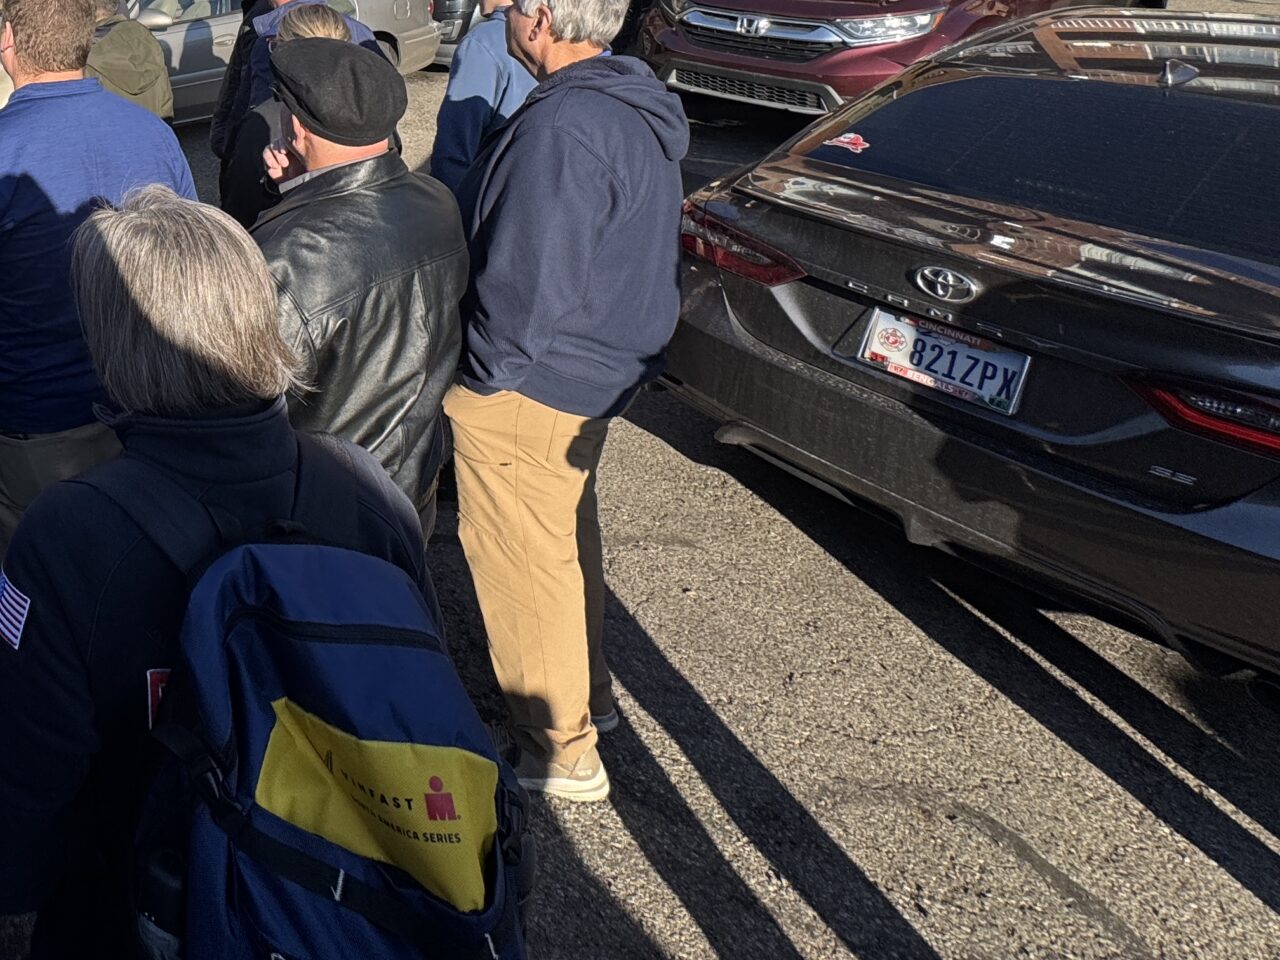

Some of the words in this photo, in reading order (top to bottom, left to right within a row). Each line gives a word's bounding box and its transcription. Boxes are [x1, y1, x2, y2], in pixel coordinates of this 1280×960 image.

[918, 320, 982, 346] CINCINNATI
[907, 370, 954, 393] BENGALS
[909, 338, 1018, 401] 821ZPX
[422, 832, 462, 844] SERIES
